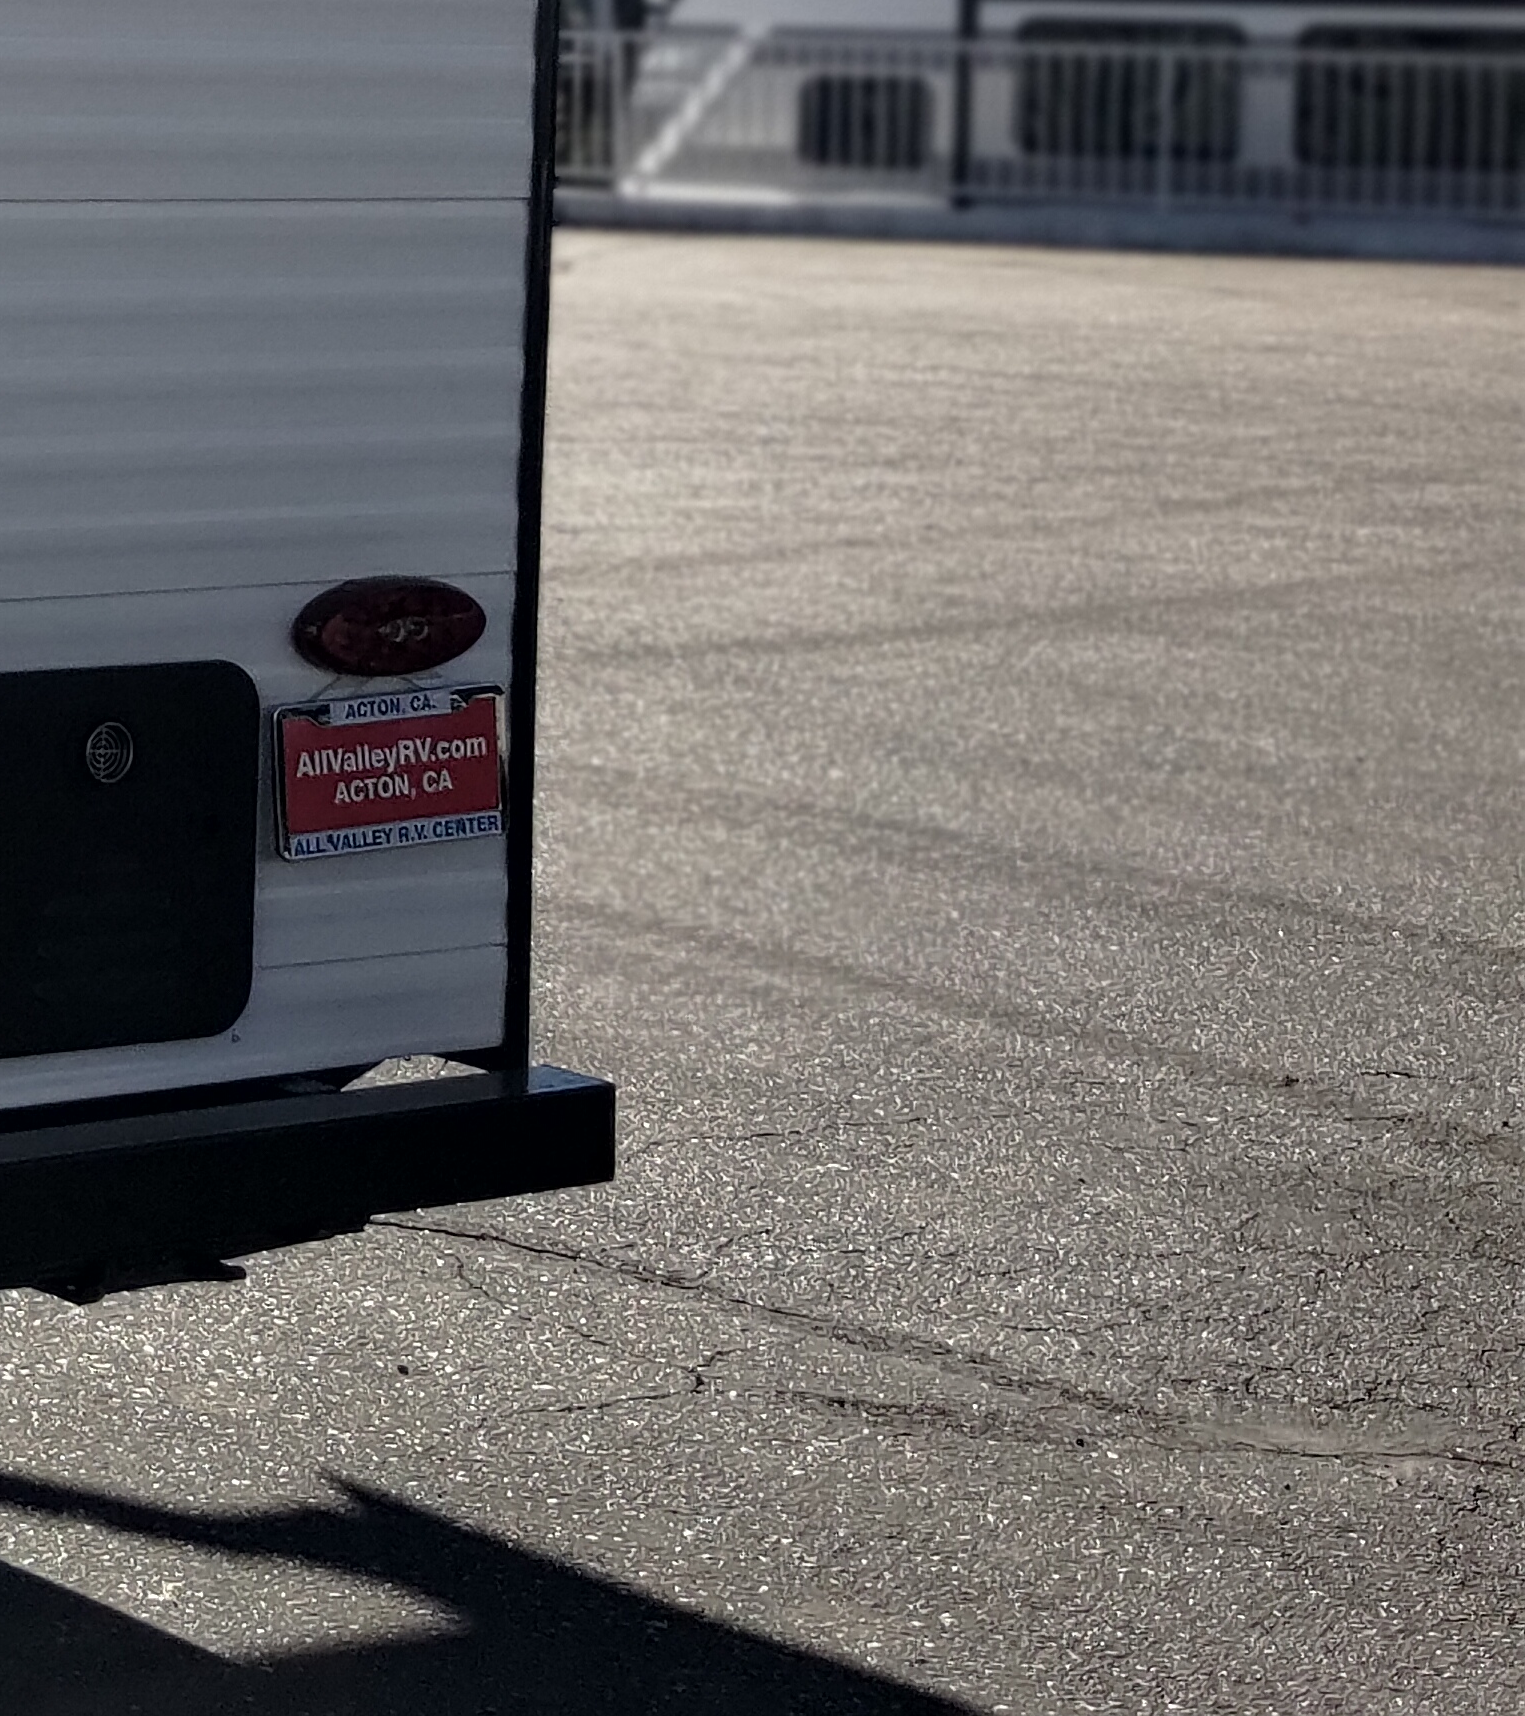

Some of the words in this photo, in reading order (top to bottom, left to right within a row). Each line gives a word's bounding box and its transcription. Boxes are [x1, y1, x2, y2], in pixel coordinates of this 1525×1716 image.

[296, 736, 487, 778] AllValleyRV.com
[334, 773, 417, 805] ACTON,
[422, 768, 454, 793] CA
[294, 834, 328, 857] ALL
[328, 827, 393, 854] VALLEY
[398, 822, 429, 844] R.V.
[432, 814, 501, 837] CENTER
